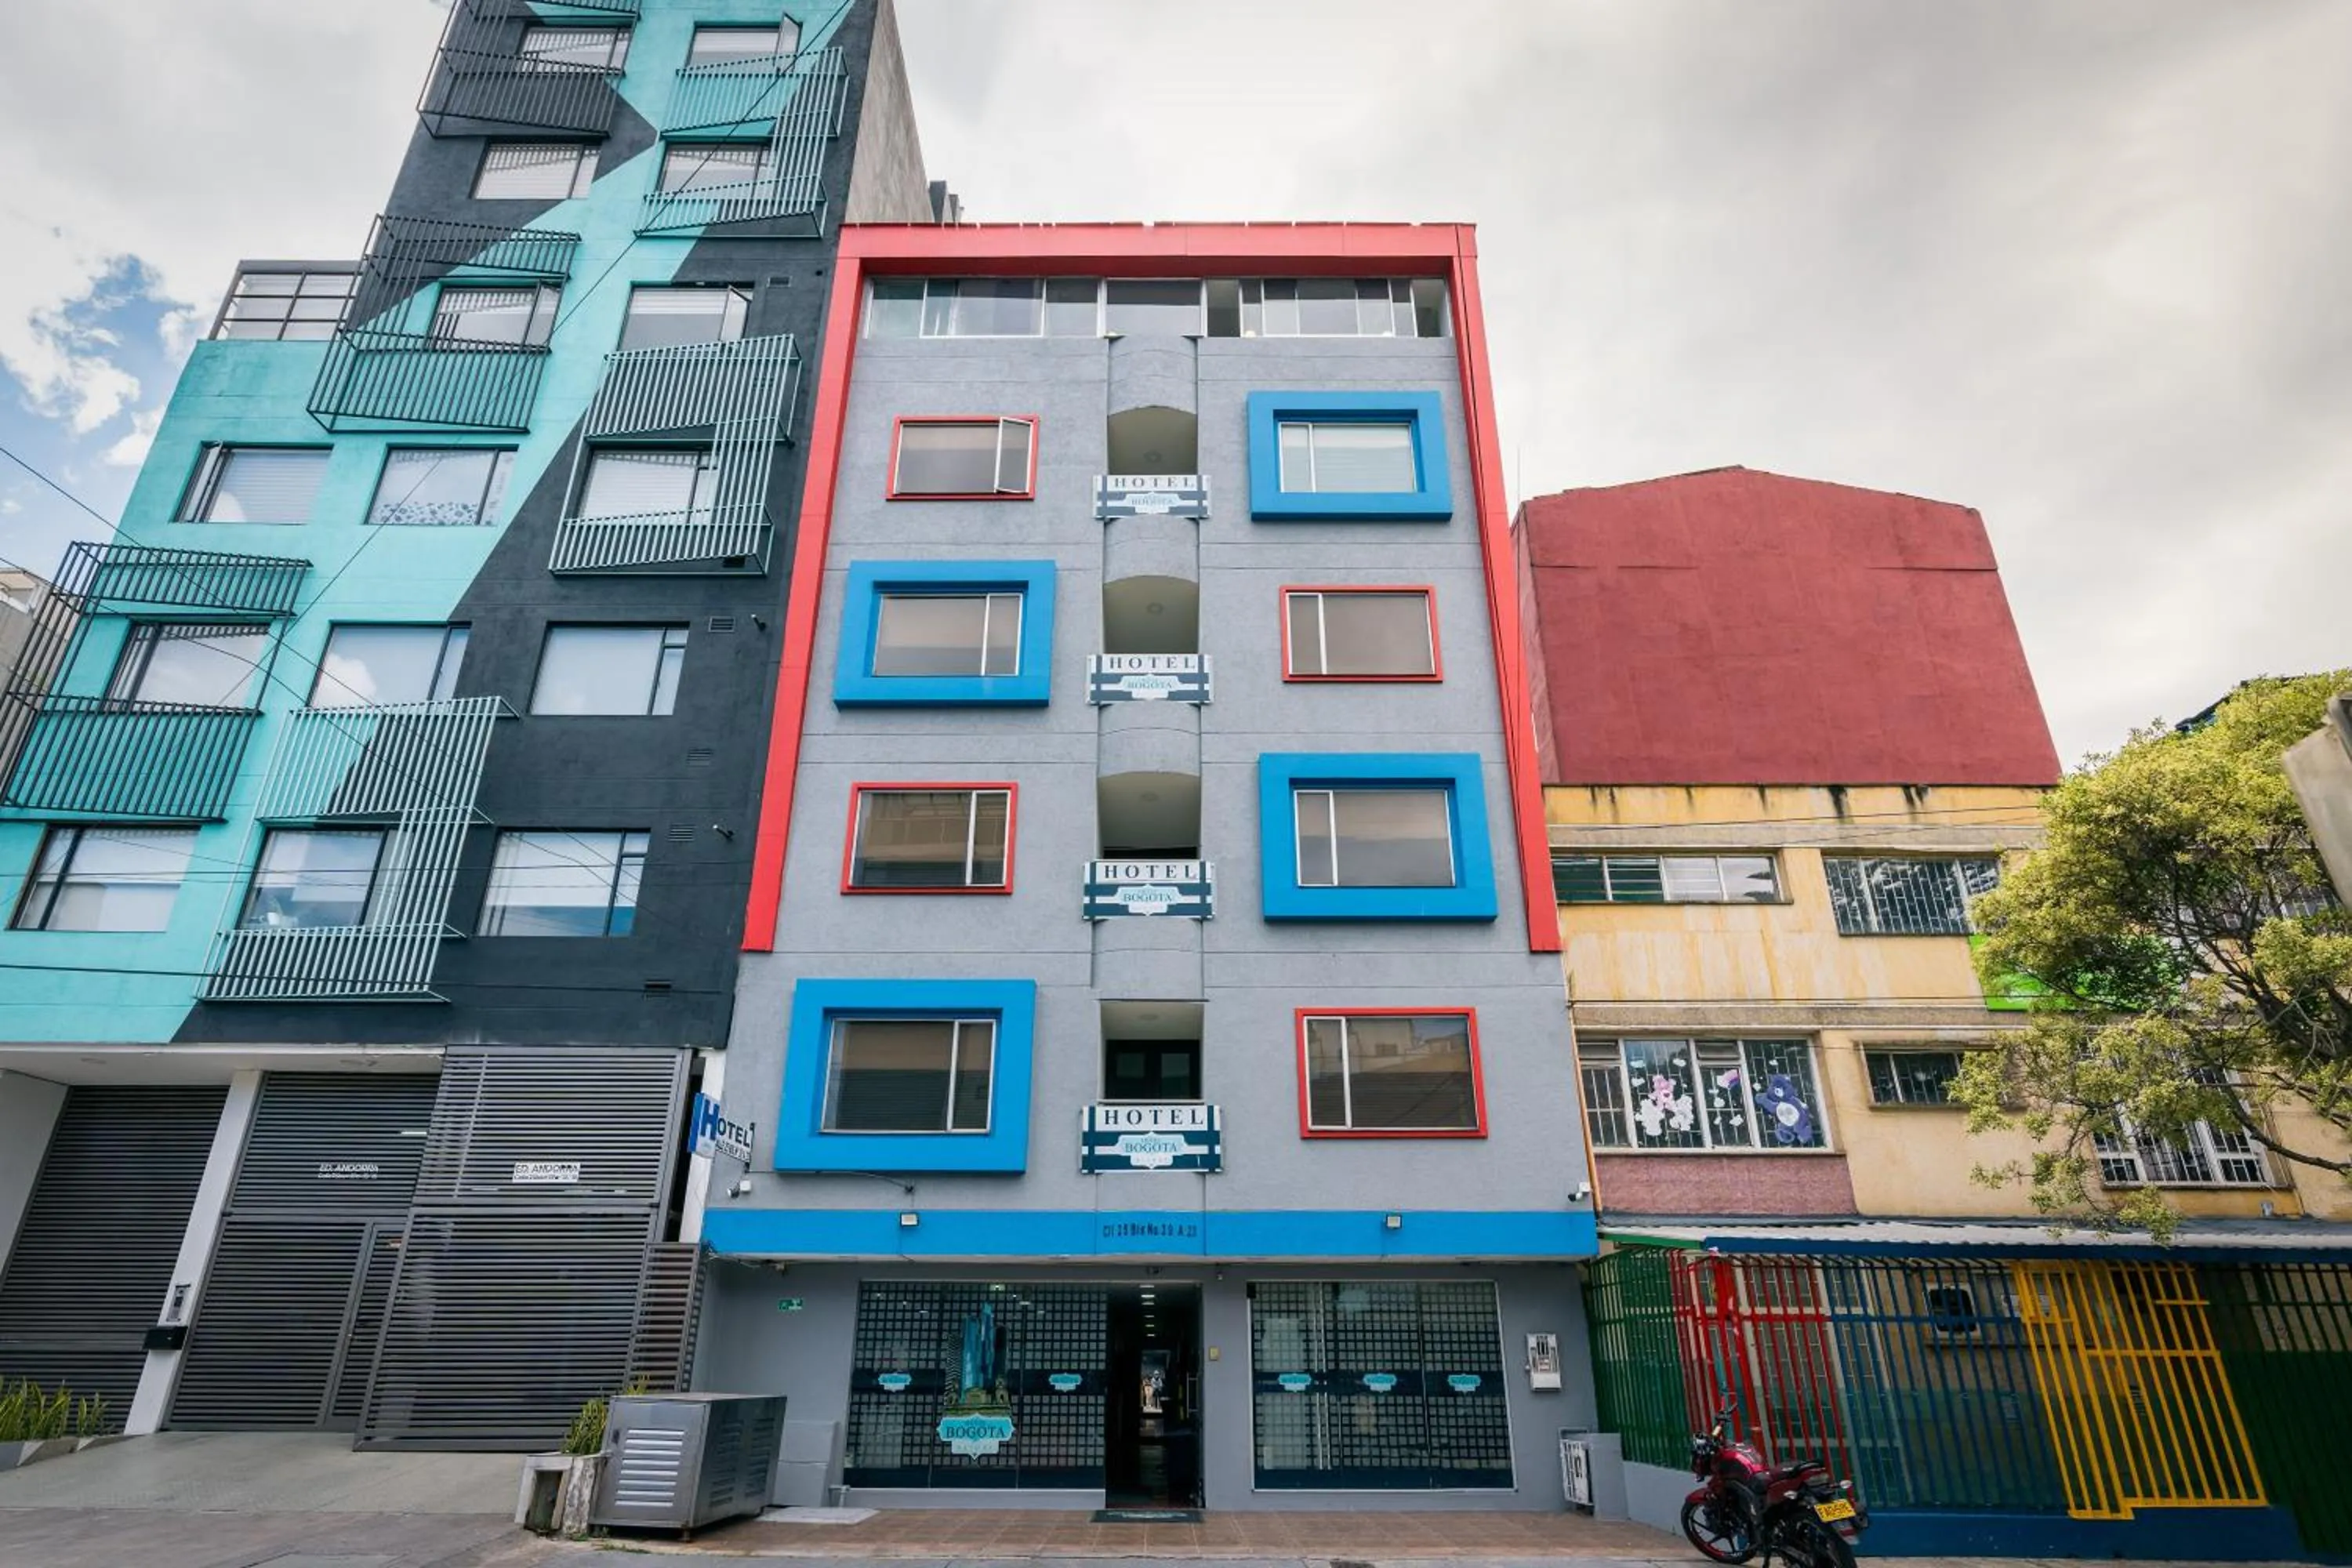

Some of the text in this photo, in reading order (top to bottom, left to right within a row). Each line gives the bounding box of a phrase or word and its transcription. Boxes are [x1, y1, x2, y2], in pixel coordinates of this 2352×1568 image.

[1115, 477, 1194, 488] HOTEL
[1109, 656, 1196, 669] HOTEL
[1104, 865, 1196, 879] HOTEL
[1123, 892, 1173, 902] BOGOTA
[699, 1099, 750, 1147] HOTEL
[1105, 1109, 1203, 1125] HOTEL
[1125, 1143, 1177, 1153] BOGOTA
[946, 1425, 1006, 1439] BOGOTA
